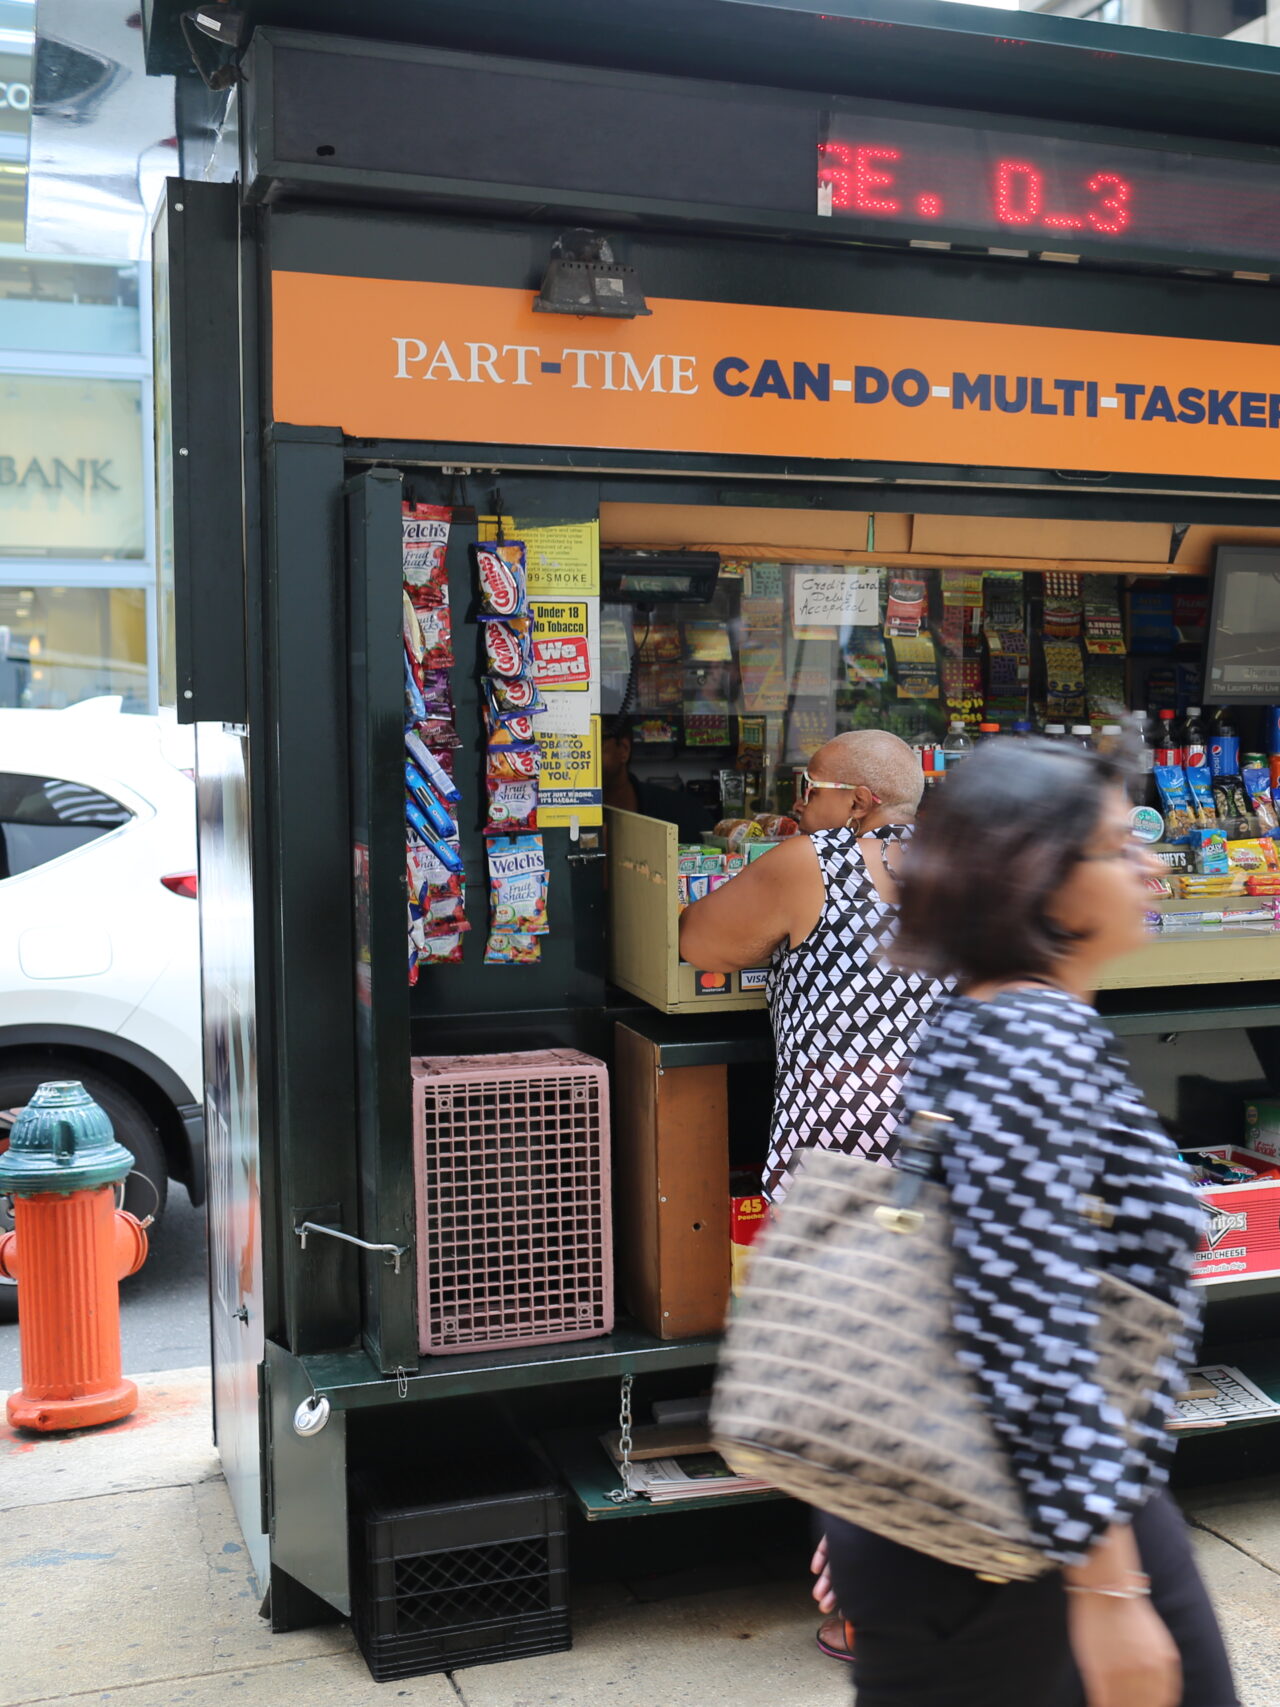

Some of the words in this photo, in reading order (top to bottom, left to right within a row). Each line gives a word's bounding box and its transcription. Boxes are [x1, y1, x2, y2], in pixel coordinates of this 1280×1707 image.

[391, 336, 699, 395] PART-TIME
[0, 455, 122, 490] BANK
[801, 578, 846, 591] Credit
[537, 606, 565, 618] Under
[568, 607, 579, 618] 18
[533, 622, 545, 632] No
[547, 621, 584, 632] Tobacco
[1088, 621, 1121, 629] MONEY
[538, 641, 577, 660] We
[531, 656, 586, 678] Card
[1213, 684, 1226, 692] The
[505, 784, 527, 792] Fruit
[500, 790, 531, 801] Snacks
[492, 853, 544, 874] Welch's
[509, 883, 531, 893] Fruit
[503, 889, 537, 901] Snacks
[746, 975, 767, 983] VISA
[740, 1199, 762, 1213] 45
[1201, 1213, 1246, 1231] oritos
[1214, 1248, 1246, 1260] CHEESE
[1230, 1261, 1247, 1271] Chips
